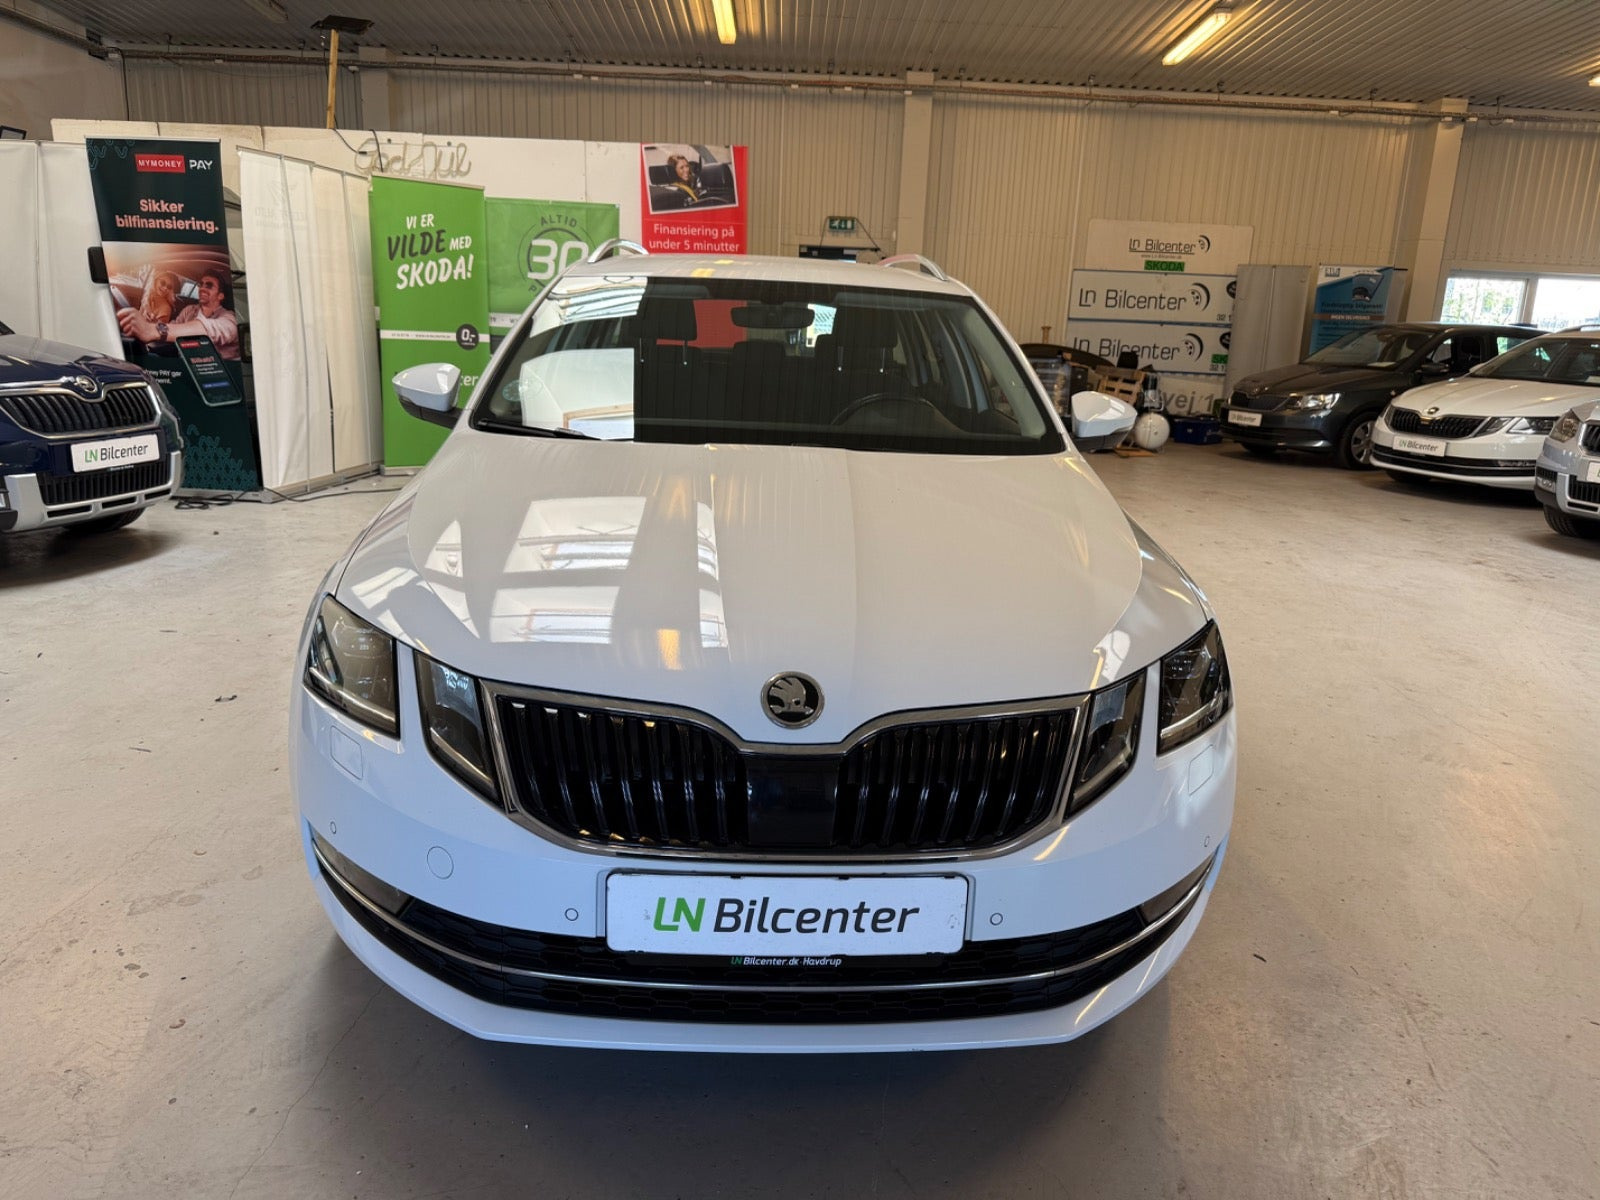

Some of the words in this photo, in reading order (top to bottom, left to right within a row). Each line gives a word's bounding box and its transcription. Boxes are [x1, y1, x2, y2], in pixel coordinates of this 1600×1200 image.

[138, 159, 182, 168] MYMONEY
[189, 159, 213, 170] PAY
[139, 198, 185, 213] Sikker
[115, 214, 219, 234] bilfinansiering.
[406, 215, 417, 230] VI
[420, 213, 435, 228] ER
[540, 214, 577, 228] ALTID
[653, 223, 719, 239] Finansiering
[721, 225, 735, 239] på
[387, 229, 447, 261] VILDE
[449, 235, 472, 251] MED
[649, 240, 681, 250] under
[683, 240, 690, 250] 5
[693, 240, 740, 252] minutter
[1145, 238, 1196, 253] Bilcenter
[527, 239, 589, 281] 30
[1144, 260, 1184, 272] SKODA
[396, 253, 474, 290] SKODA!
[1105, 288, 1187, 311] Bilcenter
[1099, 338, 1181, 361] Bilcenter
[84, 449, 99, 463] LN
[100, 444, 149, 461] Bilcenter
[1407, 440, 1439, 452] Bilcenter
[653, 896, 706, 932] LN
[713, 896, 920, 934] Bilcenter
[730, 956, 742, 966] LN
[743, 956, 799, 967] Bilcenter.dk
[802, 956, 842, 968] Havdrup
